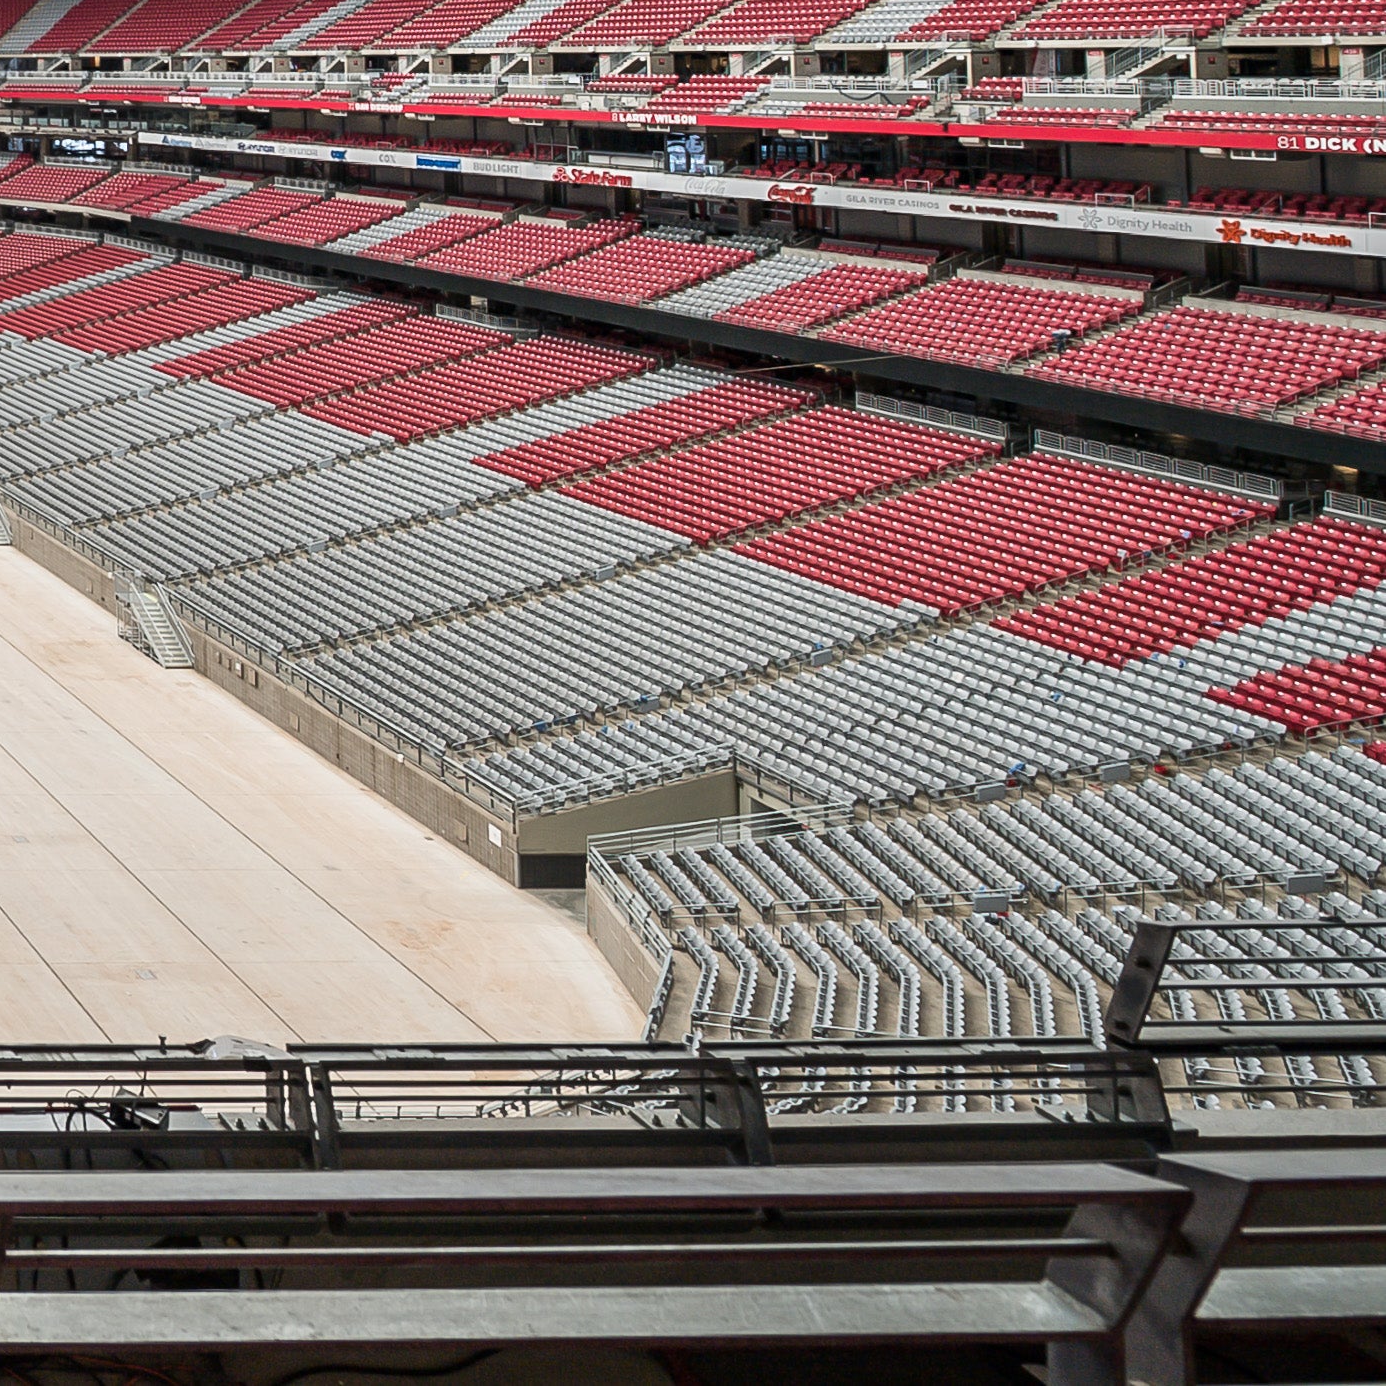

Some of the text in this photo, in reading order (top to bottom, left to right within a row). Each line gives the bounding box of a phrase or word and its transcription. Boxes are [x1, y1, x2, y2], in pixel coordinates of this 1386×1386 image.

[619, 113, 654, 123] LARRY
[654, 114, 697, 125] WILSON
[1276, 136, 1301, 150] 81
[1305, 137, 1358, 152] DICK
[473, 162, 519, 174] BUD LIGHT
[845, 194, 940, 210] GILA RIVER CASINOS
[1107, 215, 1193, 233] Dignity Health
